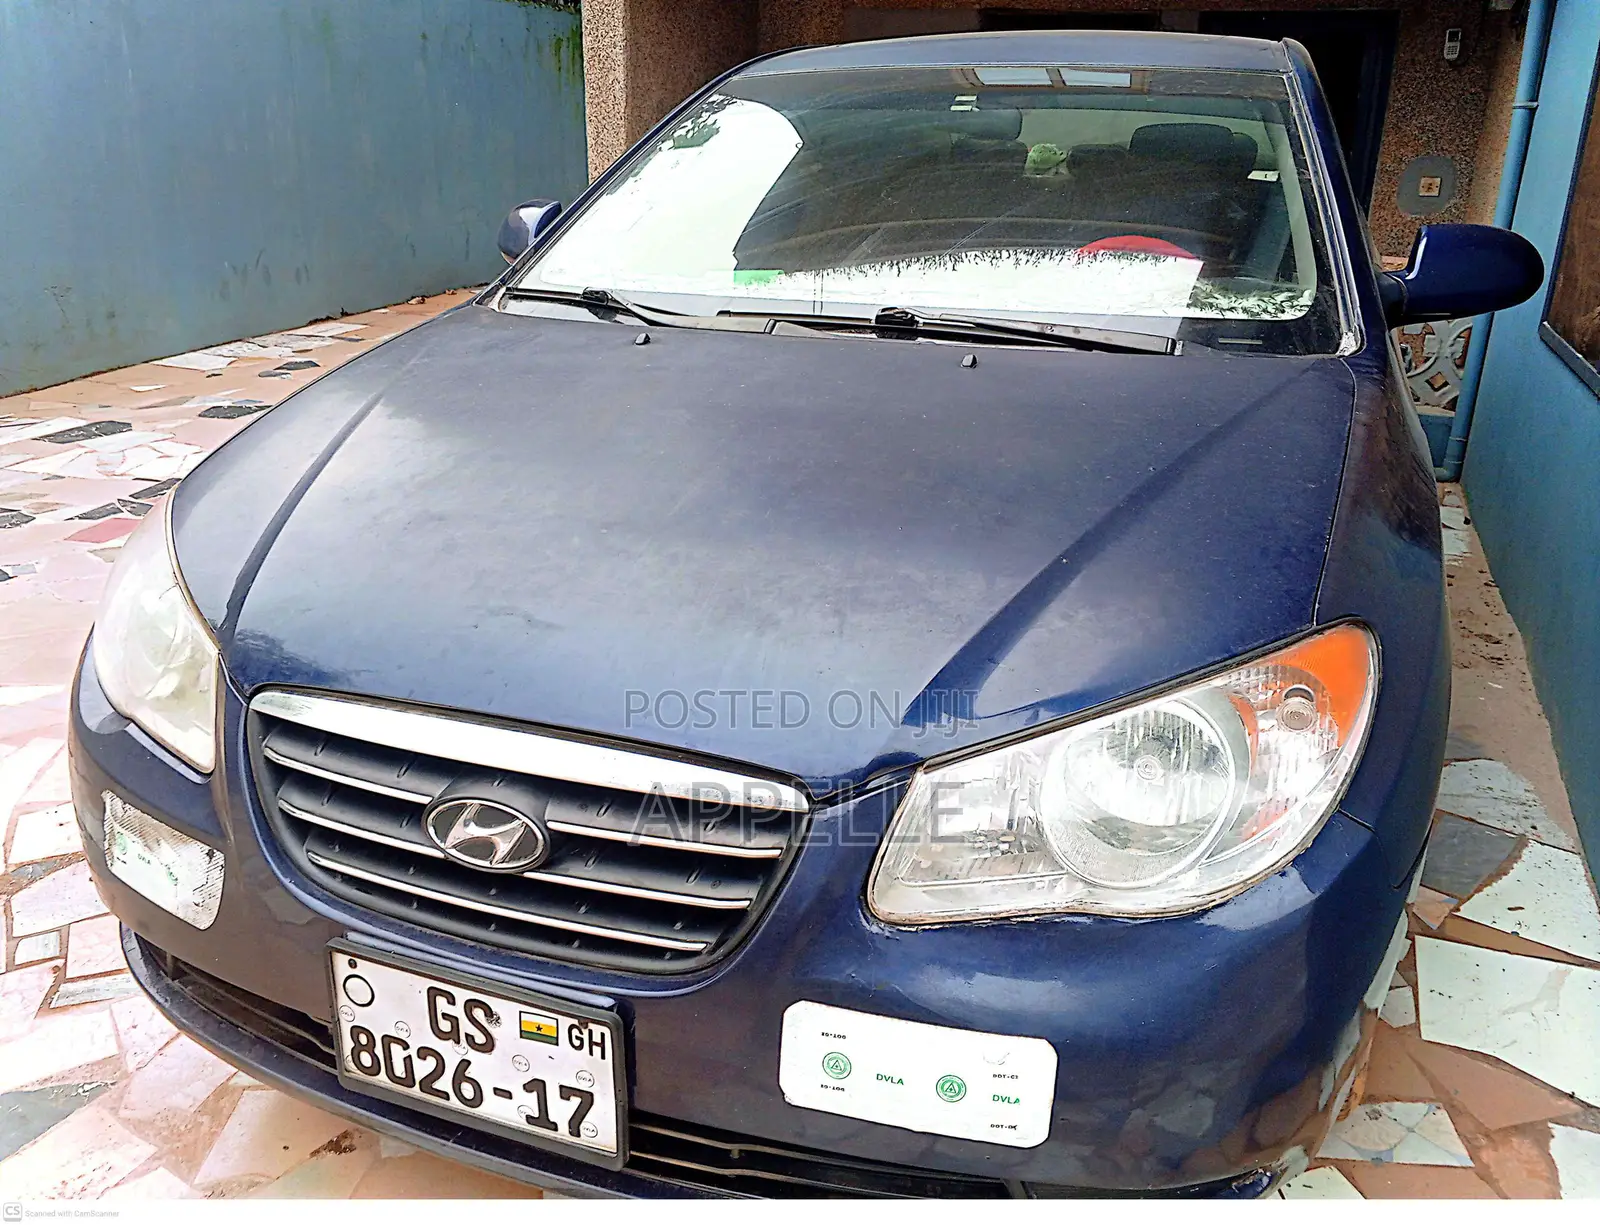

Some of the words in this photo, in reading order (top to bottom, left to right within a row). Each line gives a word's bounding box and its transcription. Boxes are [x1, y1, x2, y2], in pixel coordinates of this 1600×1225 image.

[426, 986, 496, 1054] GS
[567, 1023, 607, 1060] GH
[350, 1025, 595, 1138] 8026-17
[876, 1073, 905, 1086] DVLA
[992, 1094, 1020, 1105] DVLA
